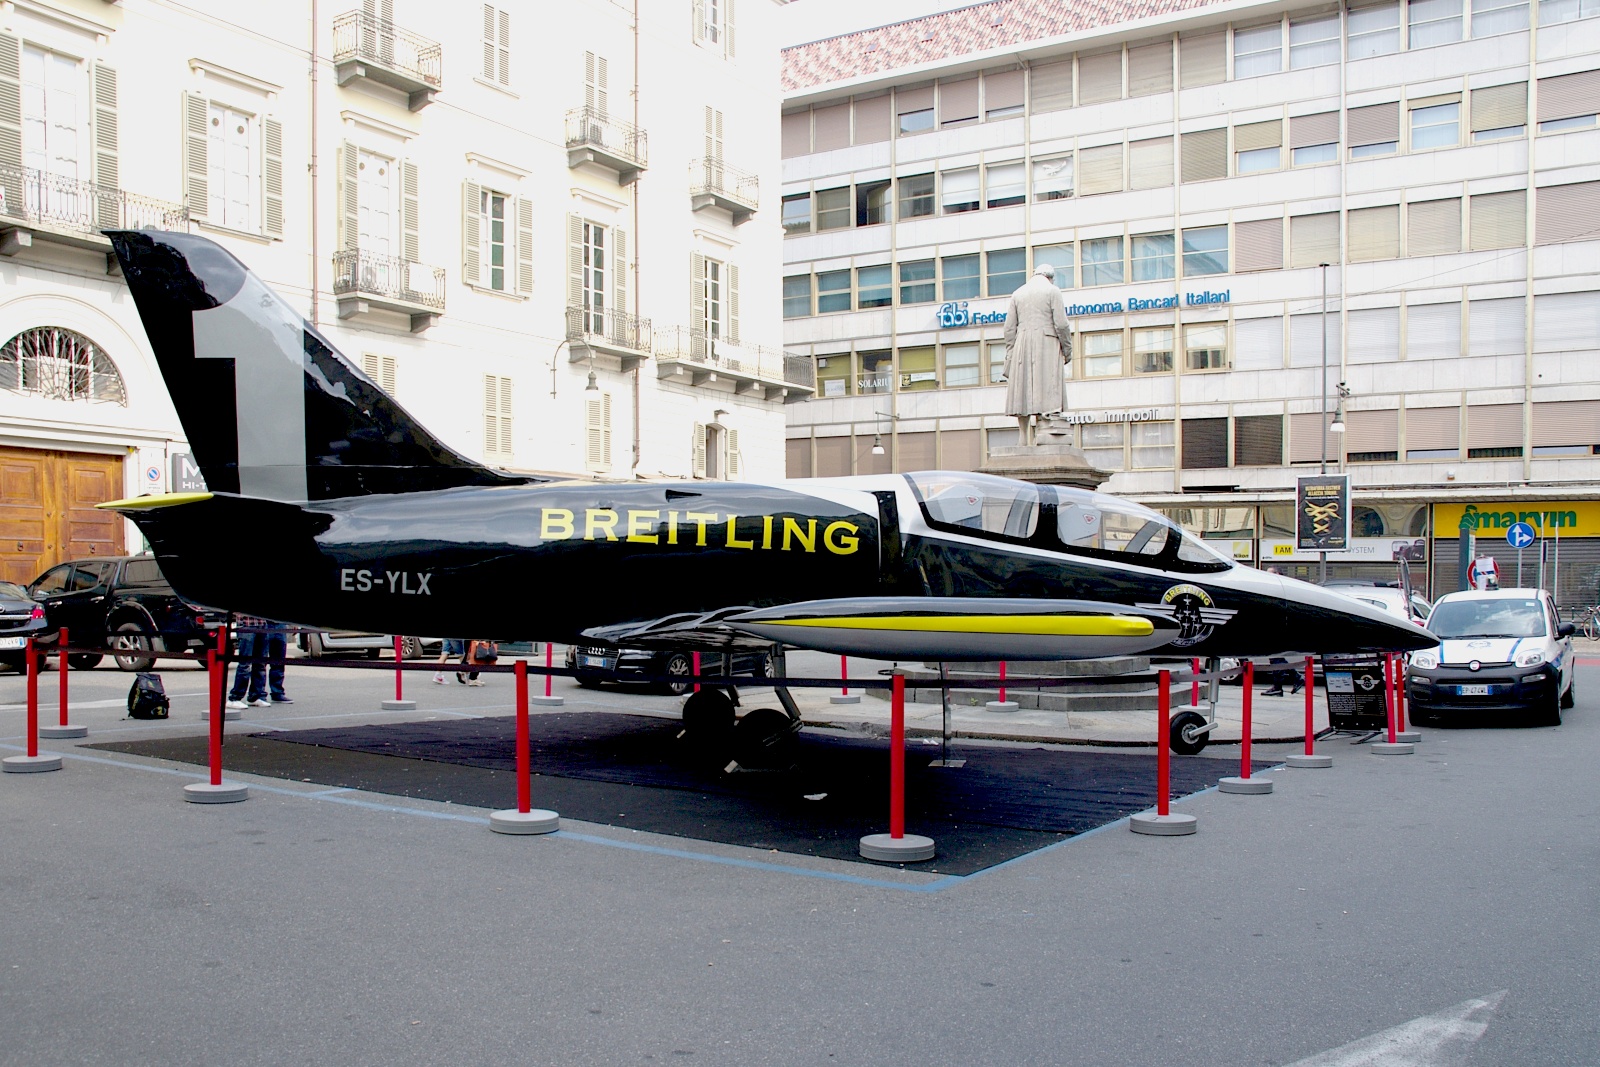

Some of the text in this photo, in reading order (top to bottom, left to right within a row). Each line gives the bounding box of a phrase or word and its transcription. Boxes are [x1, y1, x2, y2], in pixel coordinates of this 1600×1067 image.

[936, 301, 968, 328] fabi
[972, 289, 1230, 325] Feder utonoma Bancari Italiani
[192, 269, 308, 507] 1
[858, 378, 889, 389] SOLARIU
[1104, 409, 1159, 422] immobili
[539, 508, 860, 555] BREITLING
[1474, 510, 1577, 529] marvin
[341, 568, 432, 596] ES-YLX
[1164, 585, 1211, 606] BREITLING
